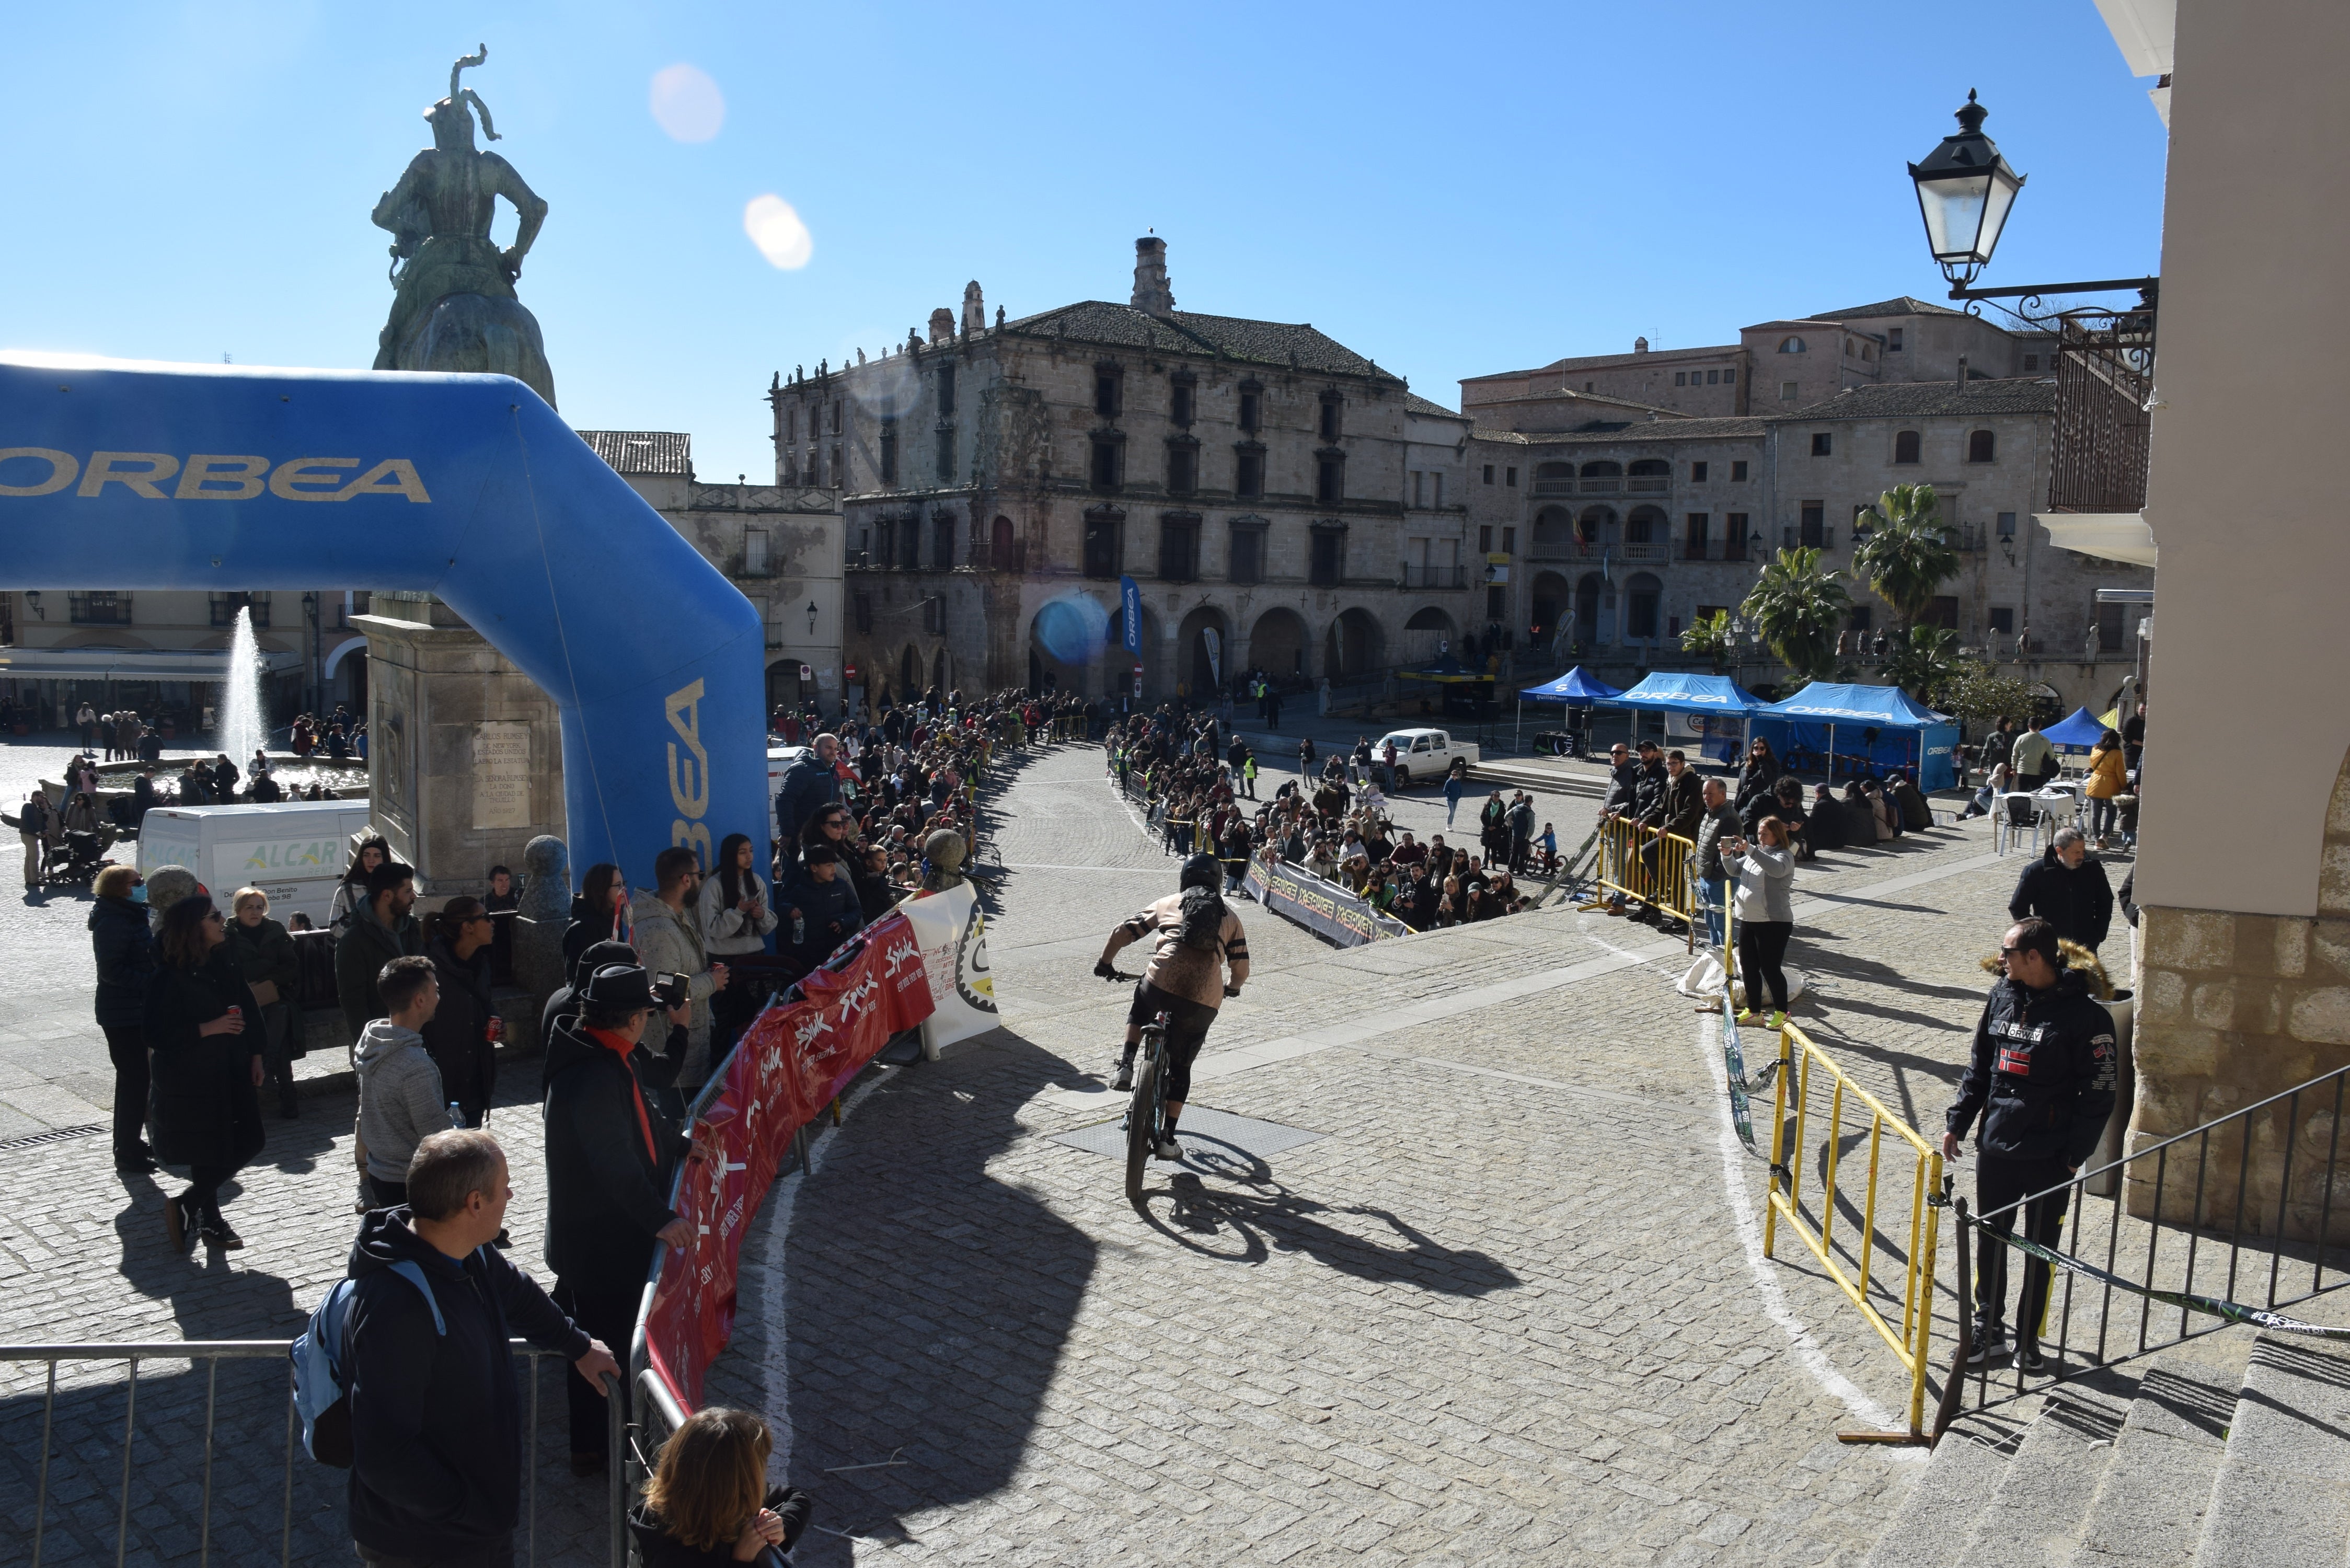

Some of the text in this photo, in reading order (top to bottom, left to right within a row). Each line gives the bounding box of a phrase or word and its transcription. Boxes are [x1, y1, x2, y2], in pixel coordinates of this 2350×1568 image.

[0, 447, 432, 503] ORBEA
[1127, 587, 1135, 646] ORBEA
[1625, 691, 1727, 704] ORBEA
[1785, 706, 1893, 720] ORBEA
[1927, 746, 1951, 755] ORBEA
[665, 677, 713, 884] BEA
[243, 841, 337, 870] ALCAR
[308, 866, 333, 876] RENT
[942, 960, 954, 969] MTB
[945, 982, 955, 991] BIKE
[1999, 1022, 2041, 1041] NORWAY
[2010, 1234, 2037, 1253] DEPORTE
[2036, 1249, 2059, 1263] SOMOS
[1923, 1249, 1935, 1298] AYTO
